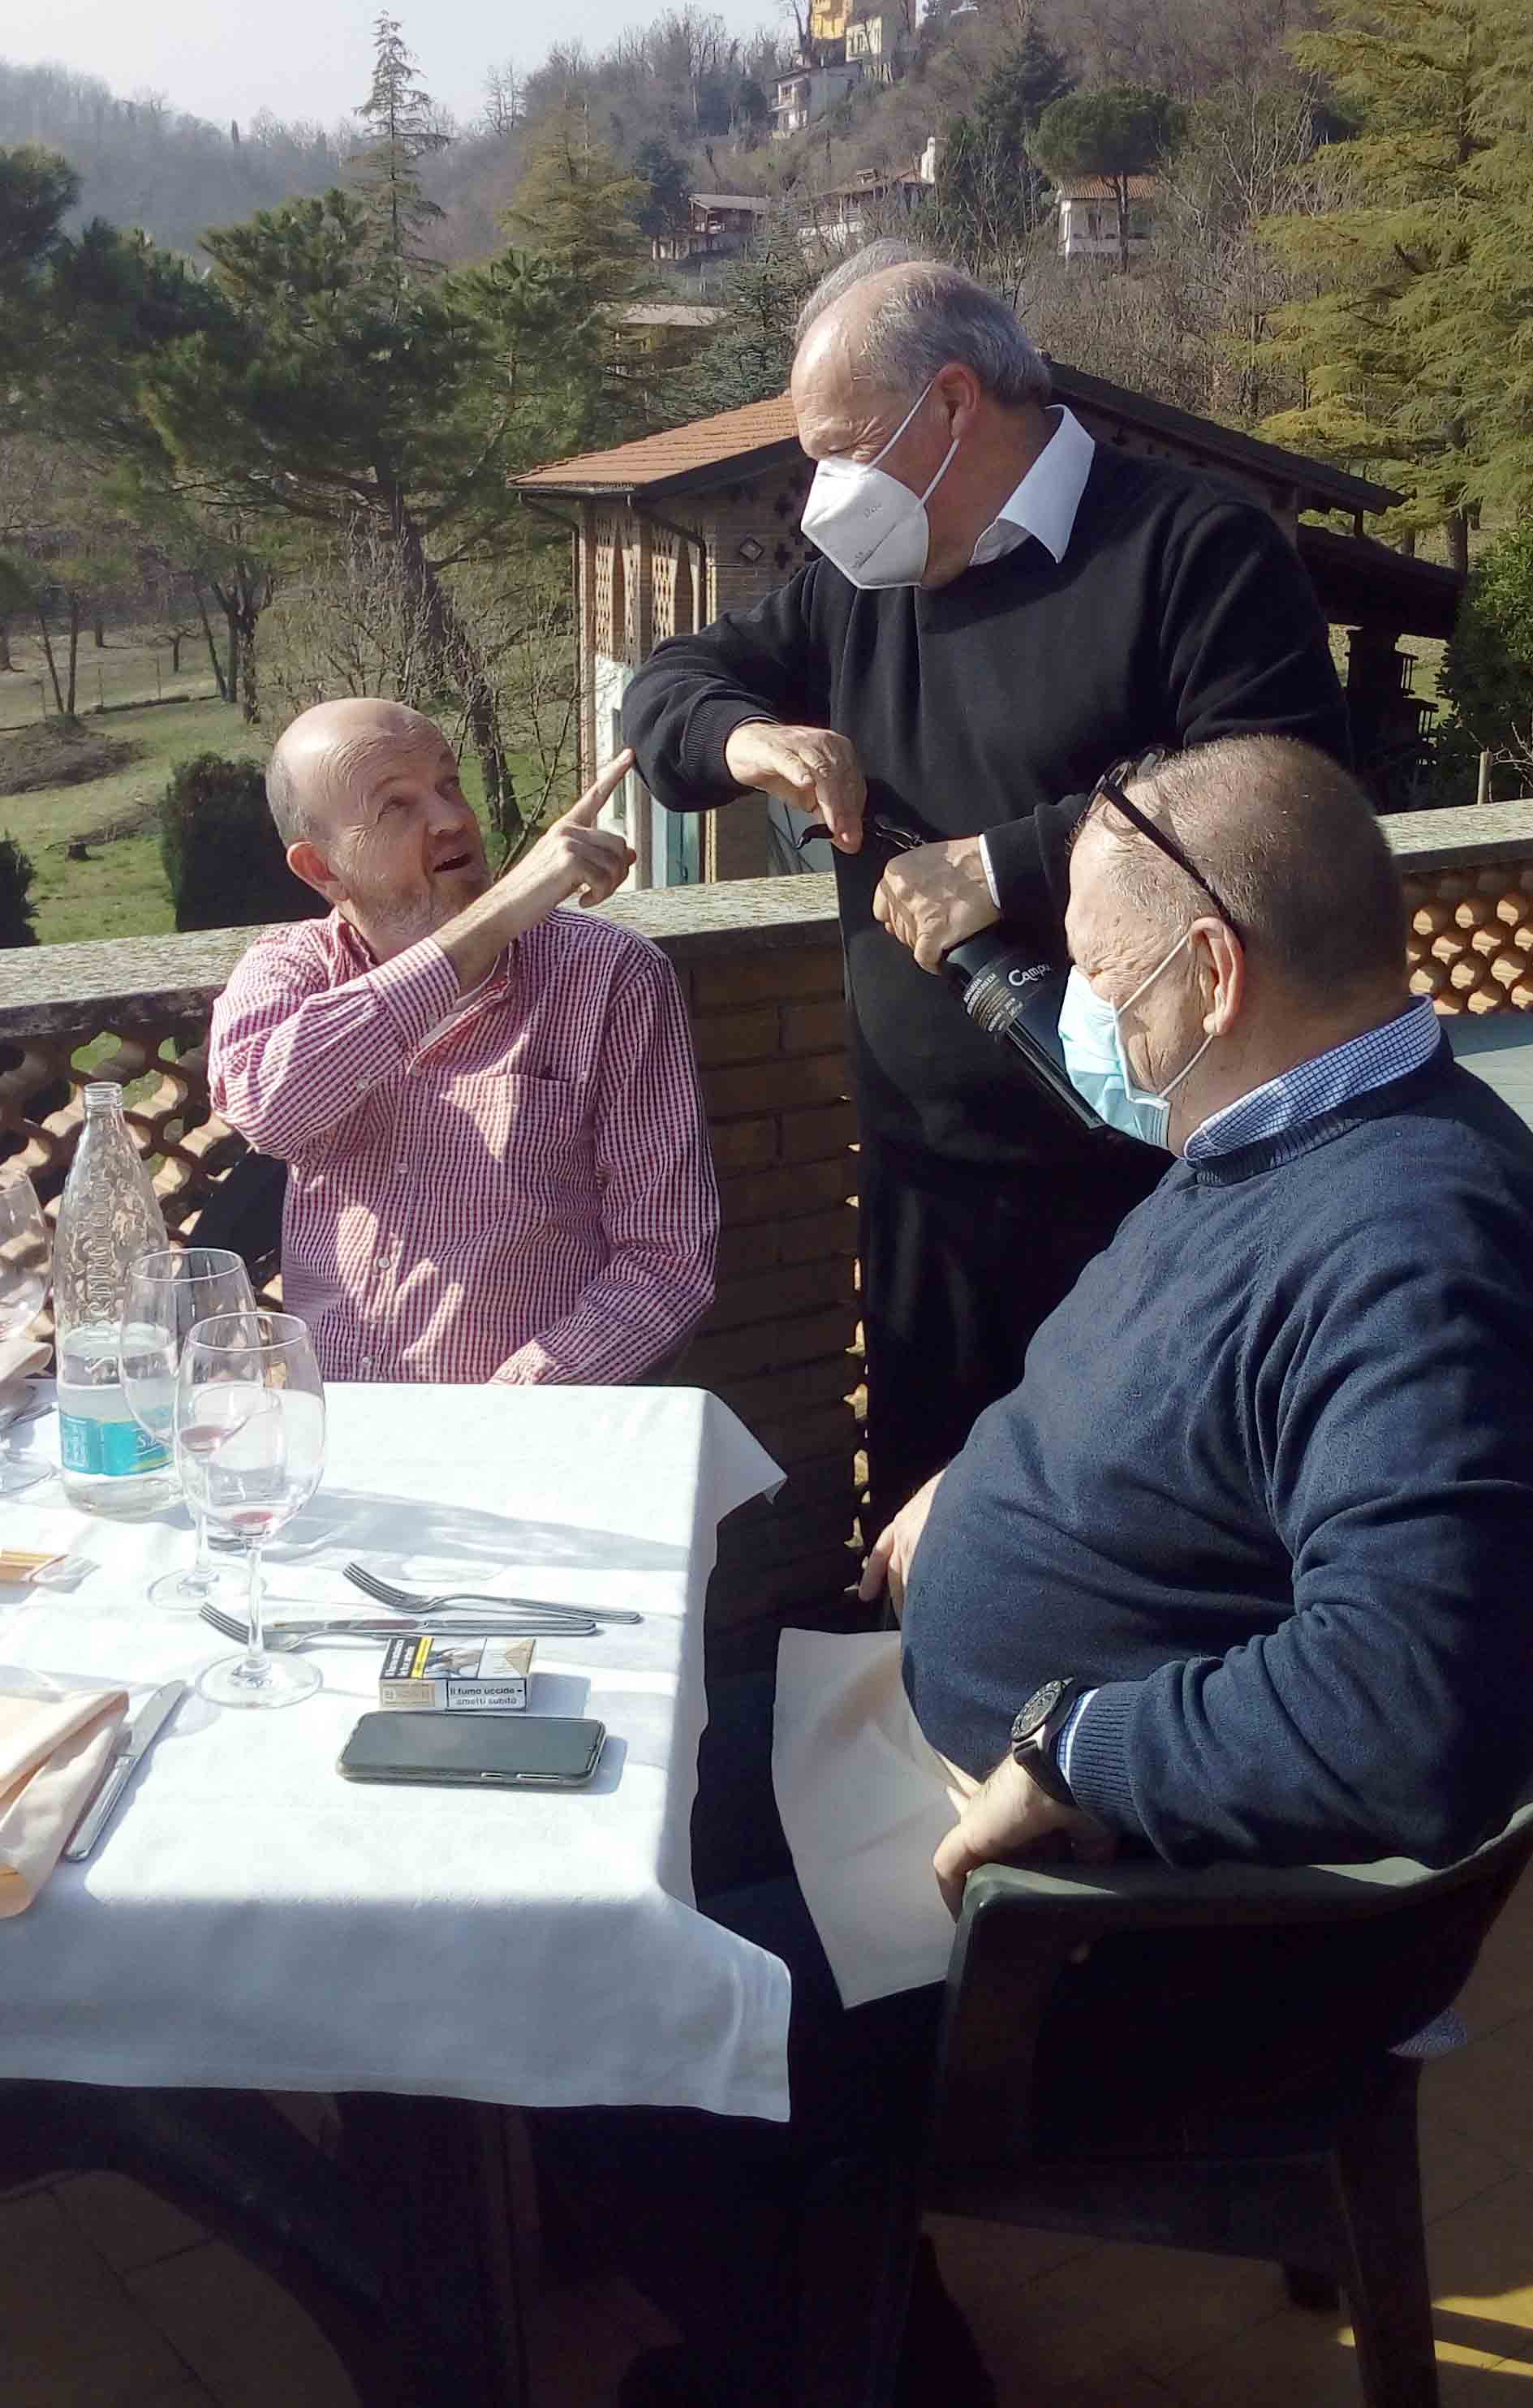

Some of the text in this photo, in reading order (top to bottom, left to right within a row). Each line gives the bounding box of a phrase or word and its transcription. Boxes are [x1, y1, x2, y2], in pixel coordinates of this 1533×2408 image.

[458, 1688, 482, 1696] fumo
[484, 1687, 515, 1696] uccide
[455, 1696, 518, 1705] smetti subito
